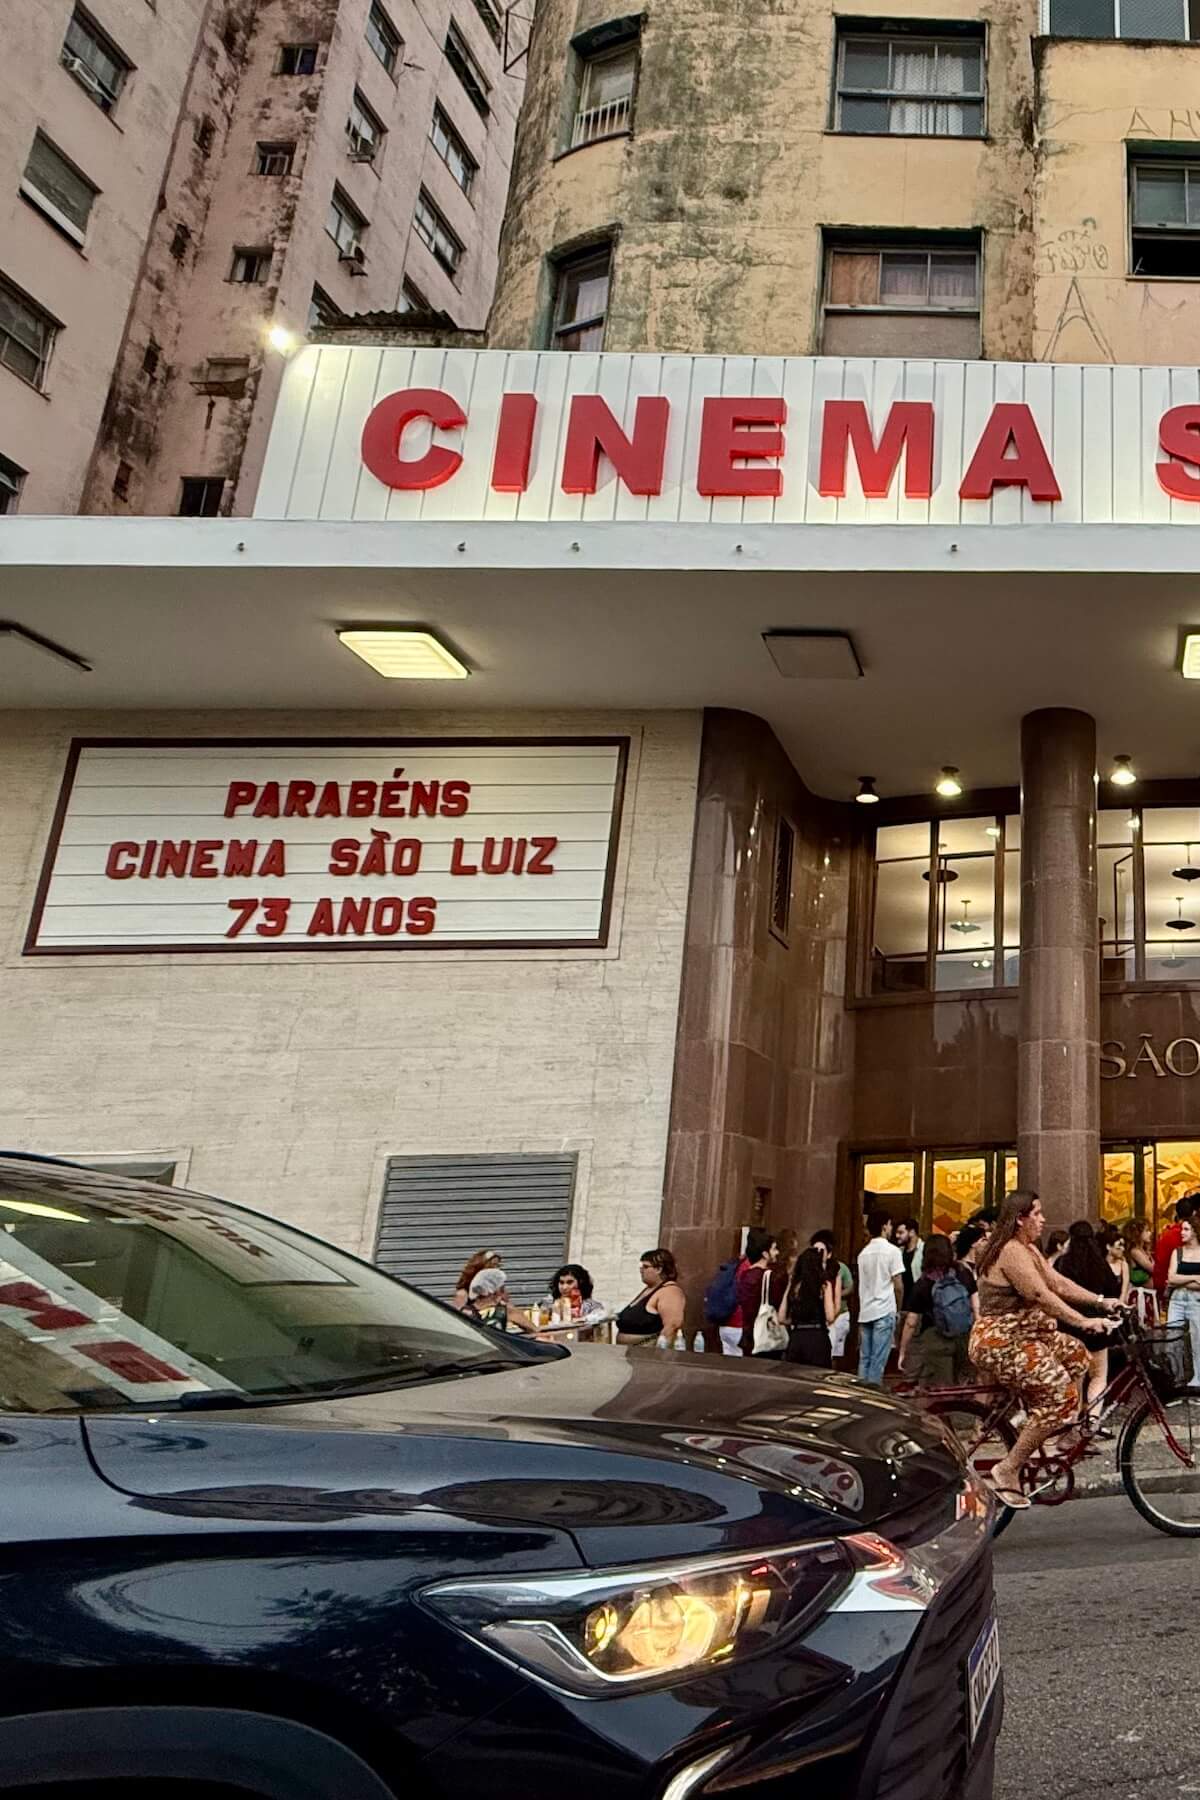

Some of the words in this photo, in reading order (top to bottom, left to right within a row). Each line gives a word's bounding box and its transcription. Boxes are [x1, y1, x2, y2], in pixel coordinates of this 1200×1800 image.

[361, 388, 1063, 503] CINEMA
[224, 769, 472, 817] PARABÉNS
[105, 839, 287, 881] CINEMA
[328, 828, 424, 877] SÃO
[450, 836, 559, 877] LUIZ
[225, 896, 292, 939] 73
[306, 896, 438, 938] ANOS
